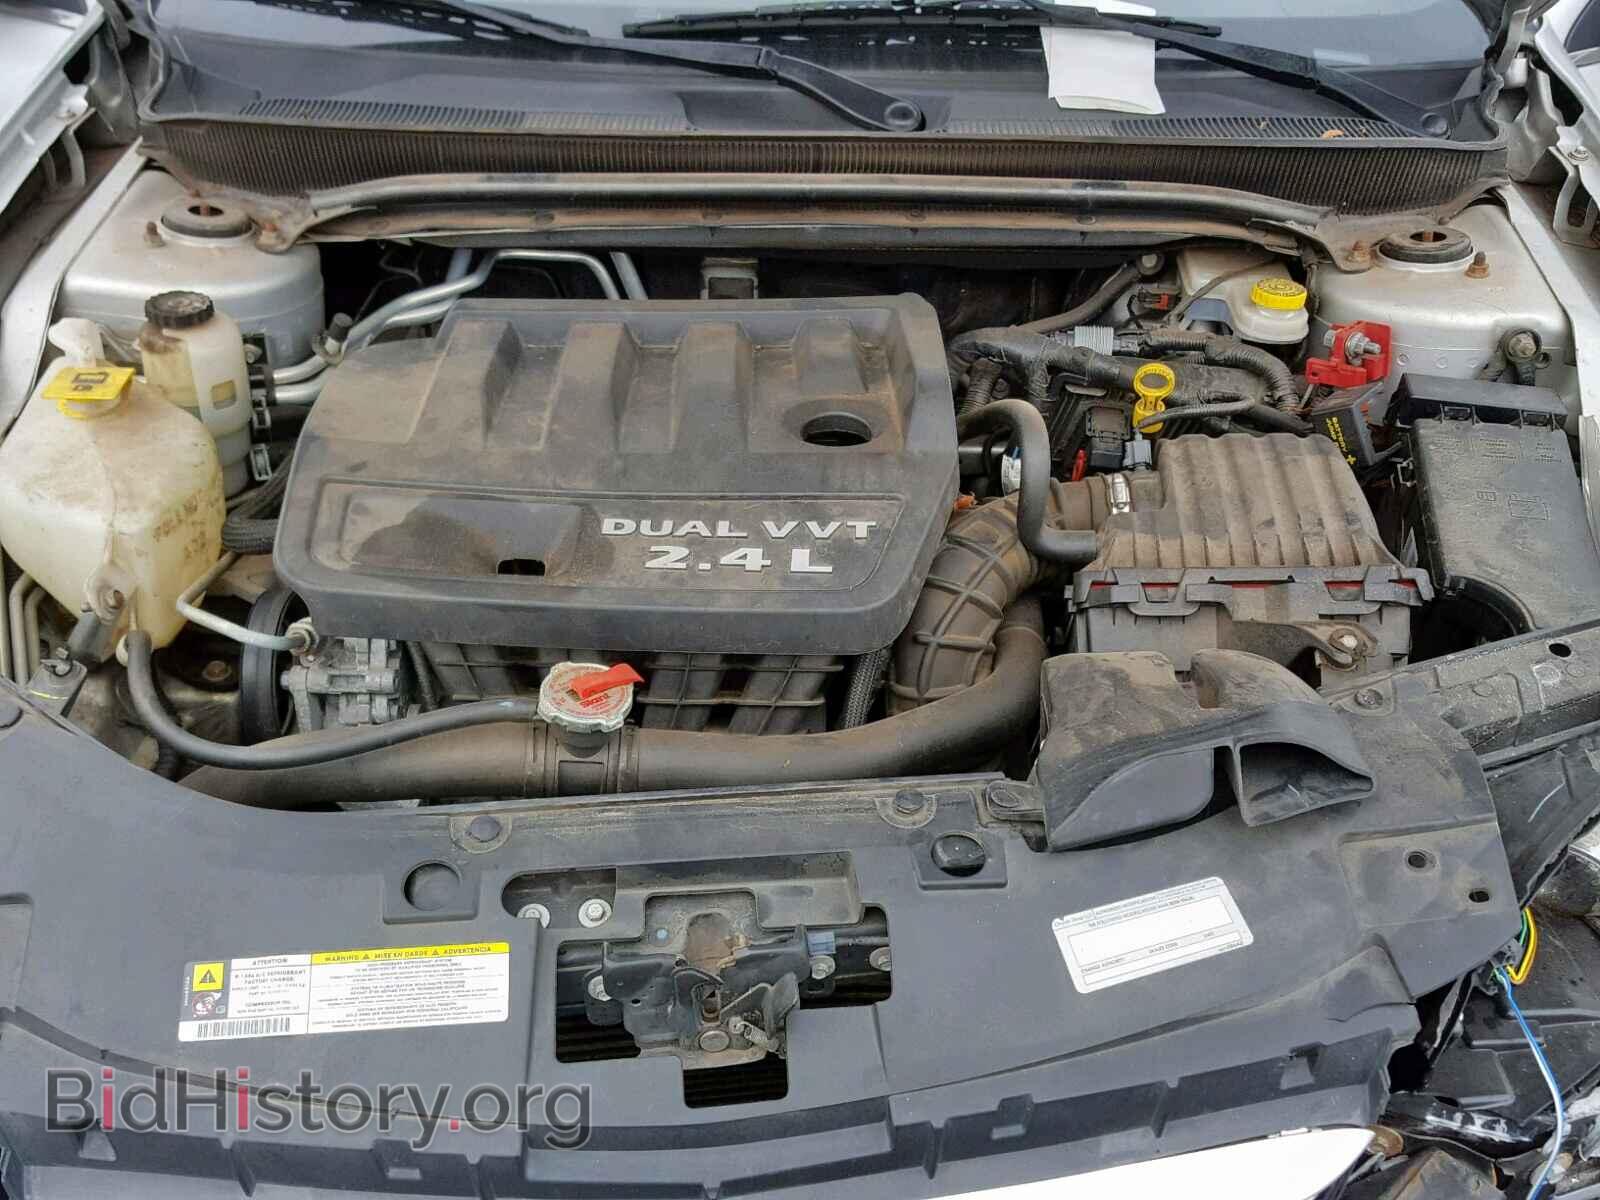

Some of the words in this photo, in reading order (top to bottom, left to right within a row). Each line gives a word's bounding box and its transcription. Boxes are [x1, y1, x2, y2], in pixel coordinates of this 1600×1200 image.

[601, 518, 748, 538] DUAL
[762, 520, 877, 539] VVT
[252, 958, 289, 966] ATTENTION
[325, 954, 360, 963] WARNING
[442, 946, 492, 956] ADVERTENCIA
